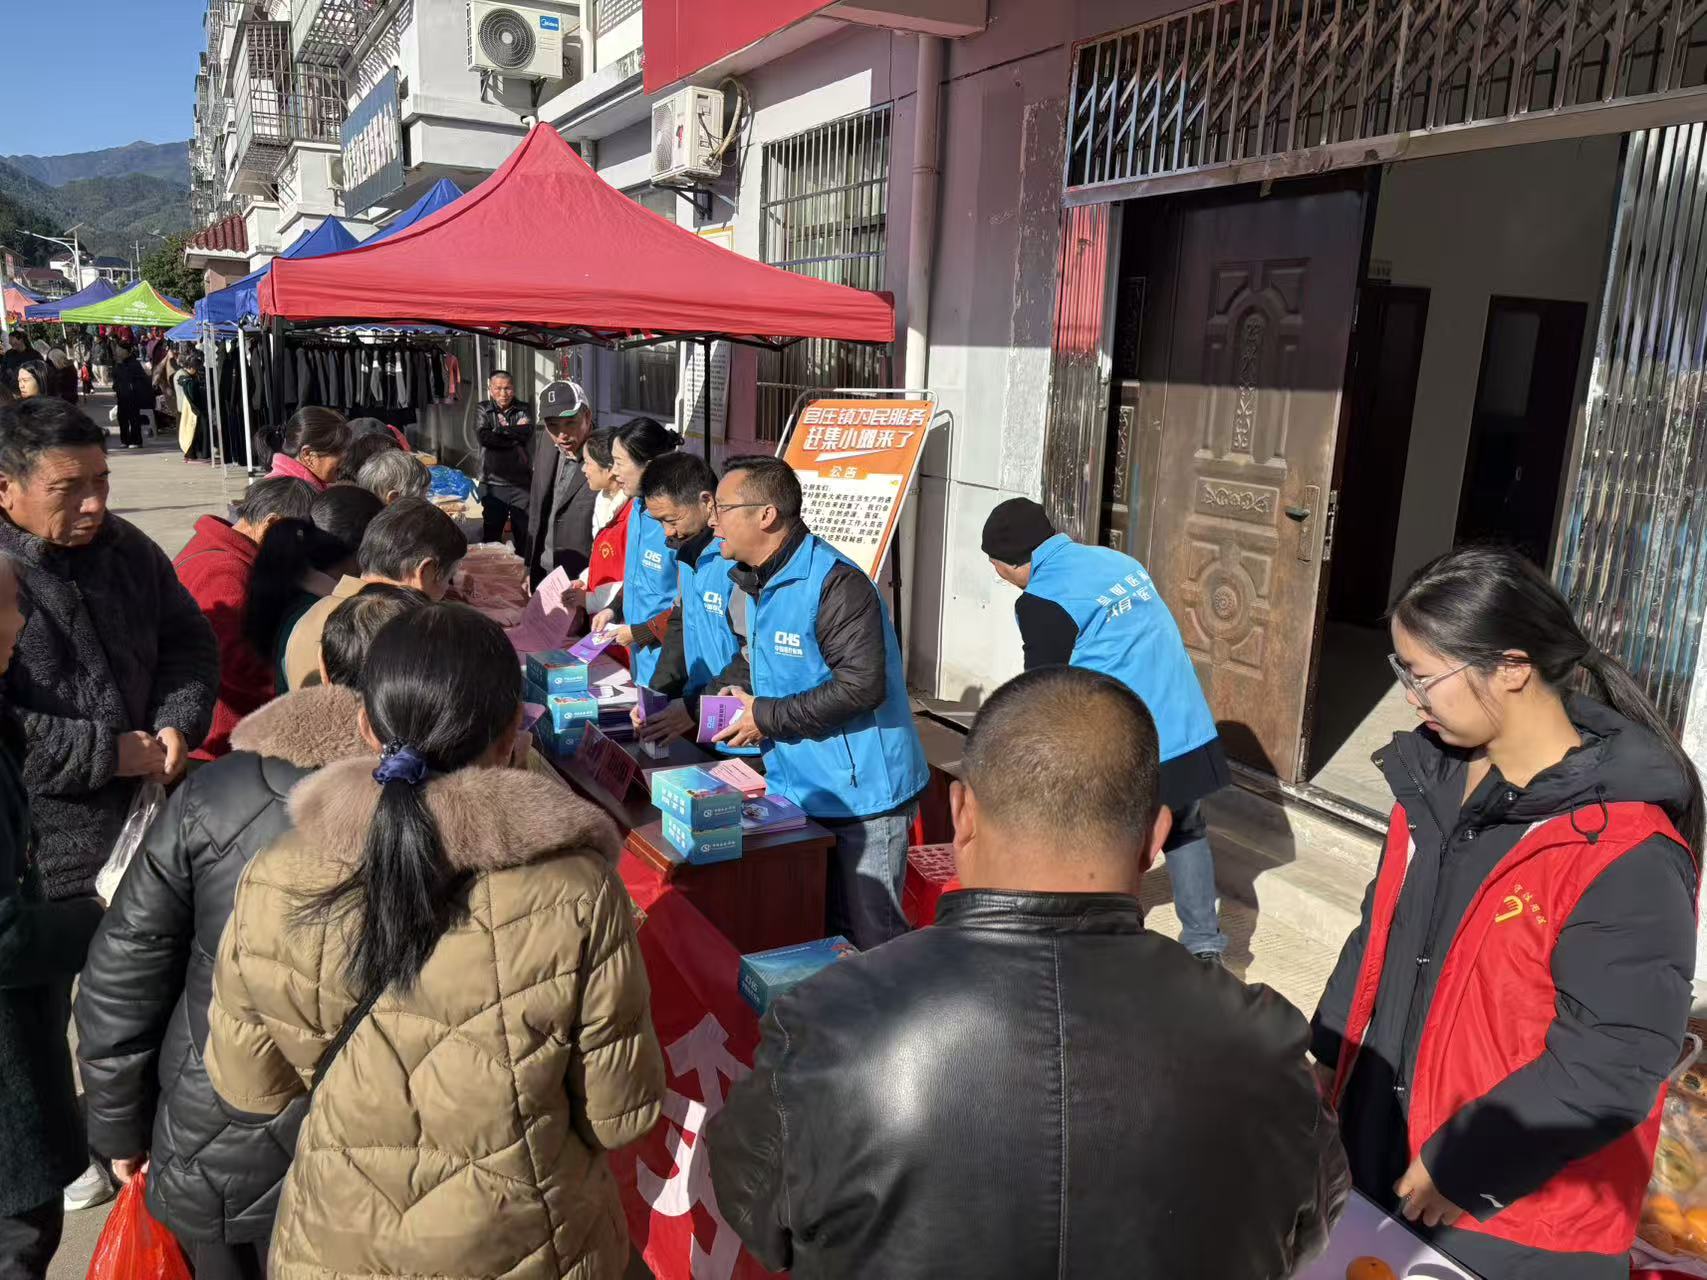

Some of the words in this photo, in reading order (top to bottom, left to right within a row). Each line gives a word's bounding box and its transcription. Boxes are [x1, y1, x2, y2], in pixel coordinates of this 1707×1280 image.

[802, 407, 927, 426] 官庄镇为民服务
[802, 426, 915, 451] 赶集小摊来了
[830, 465, 858, 479] 公告
[774, 631, 801, 647] CHS
